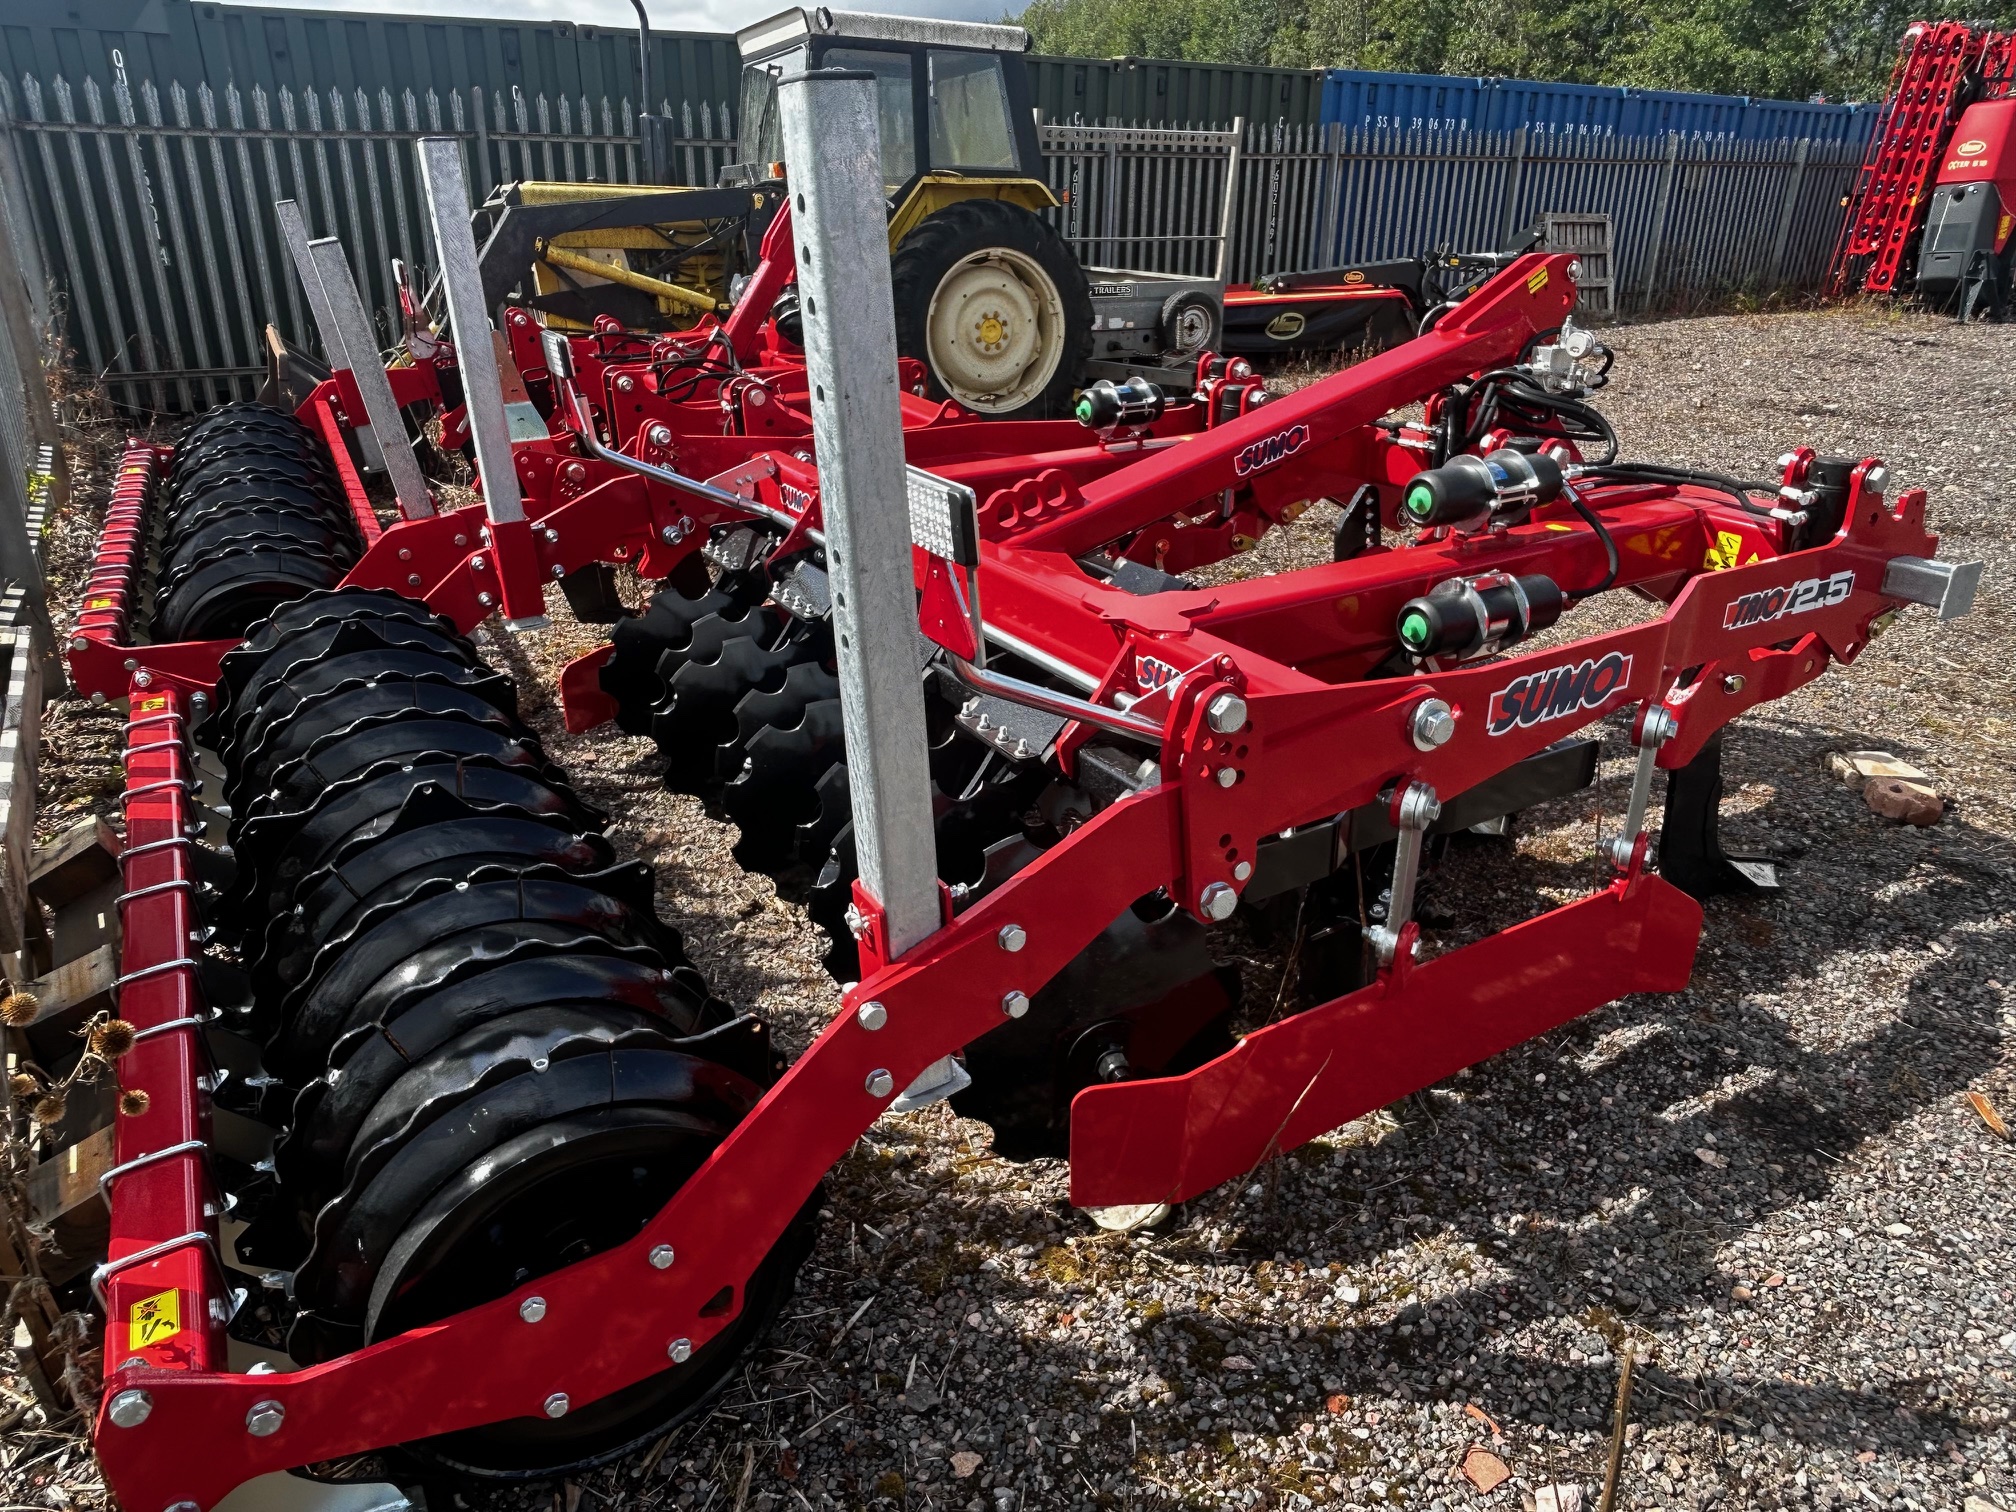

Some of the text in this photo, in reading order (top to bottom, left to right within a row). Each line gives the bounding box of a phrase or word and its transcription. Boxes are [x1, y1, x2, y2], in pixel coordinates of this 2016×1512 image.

[1093, 286, 1131, 294] TRAILERS
[1238, 425, 1304, 475] SUMO
[1489, 652, 1626, 735] SUMO
